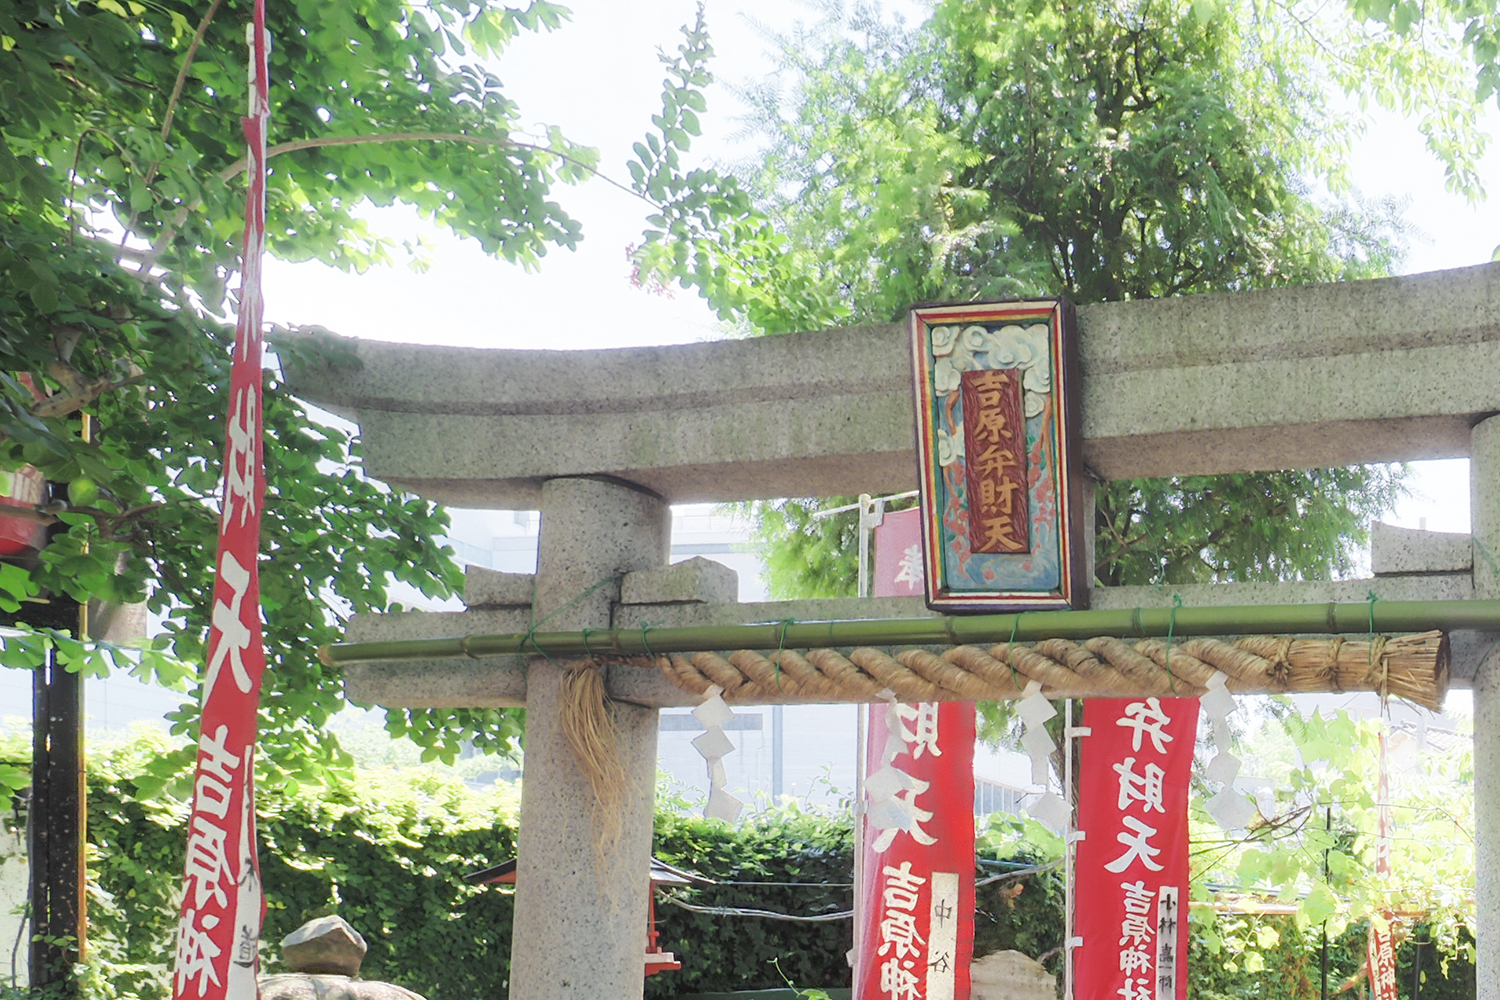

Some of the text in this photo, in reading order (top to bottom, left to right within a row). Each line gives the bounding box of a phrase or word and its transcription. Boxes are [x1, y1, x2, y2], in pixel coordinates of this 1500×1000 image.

[969, 373, 1024, 553] 吉原弁財天
